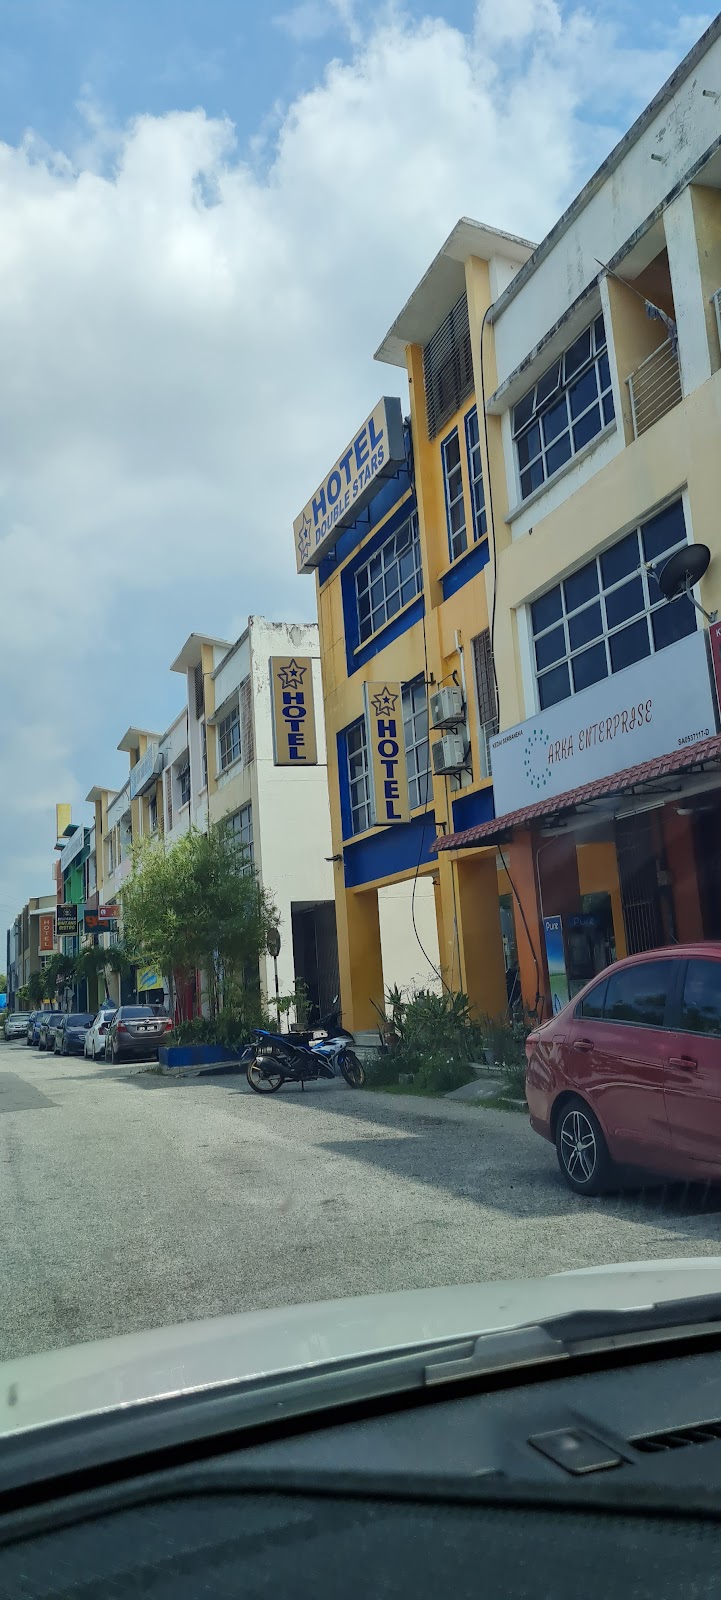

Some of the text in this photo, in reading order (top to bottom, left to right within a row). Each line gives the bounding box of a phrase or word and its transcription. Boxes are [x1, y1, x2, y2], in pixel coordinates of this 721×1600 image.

[312, 416, 383, 527] HOTEL
[315, 443, 384, 546] DOUBLE STARS
[282, 692, 306, 760] HOTEL
[547, 699, 653, 764] ARKA ENTERPRISE
[377, 719, 402, 819] HOTEL
[546, 921, 559, 931] Pure
